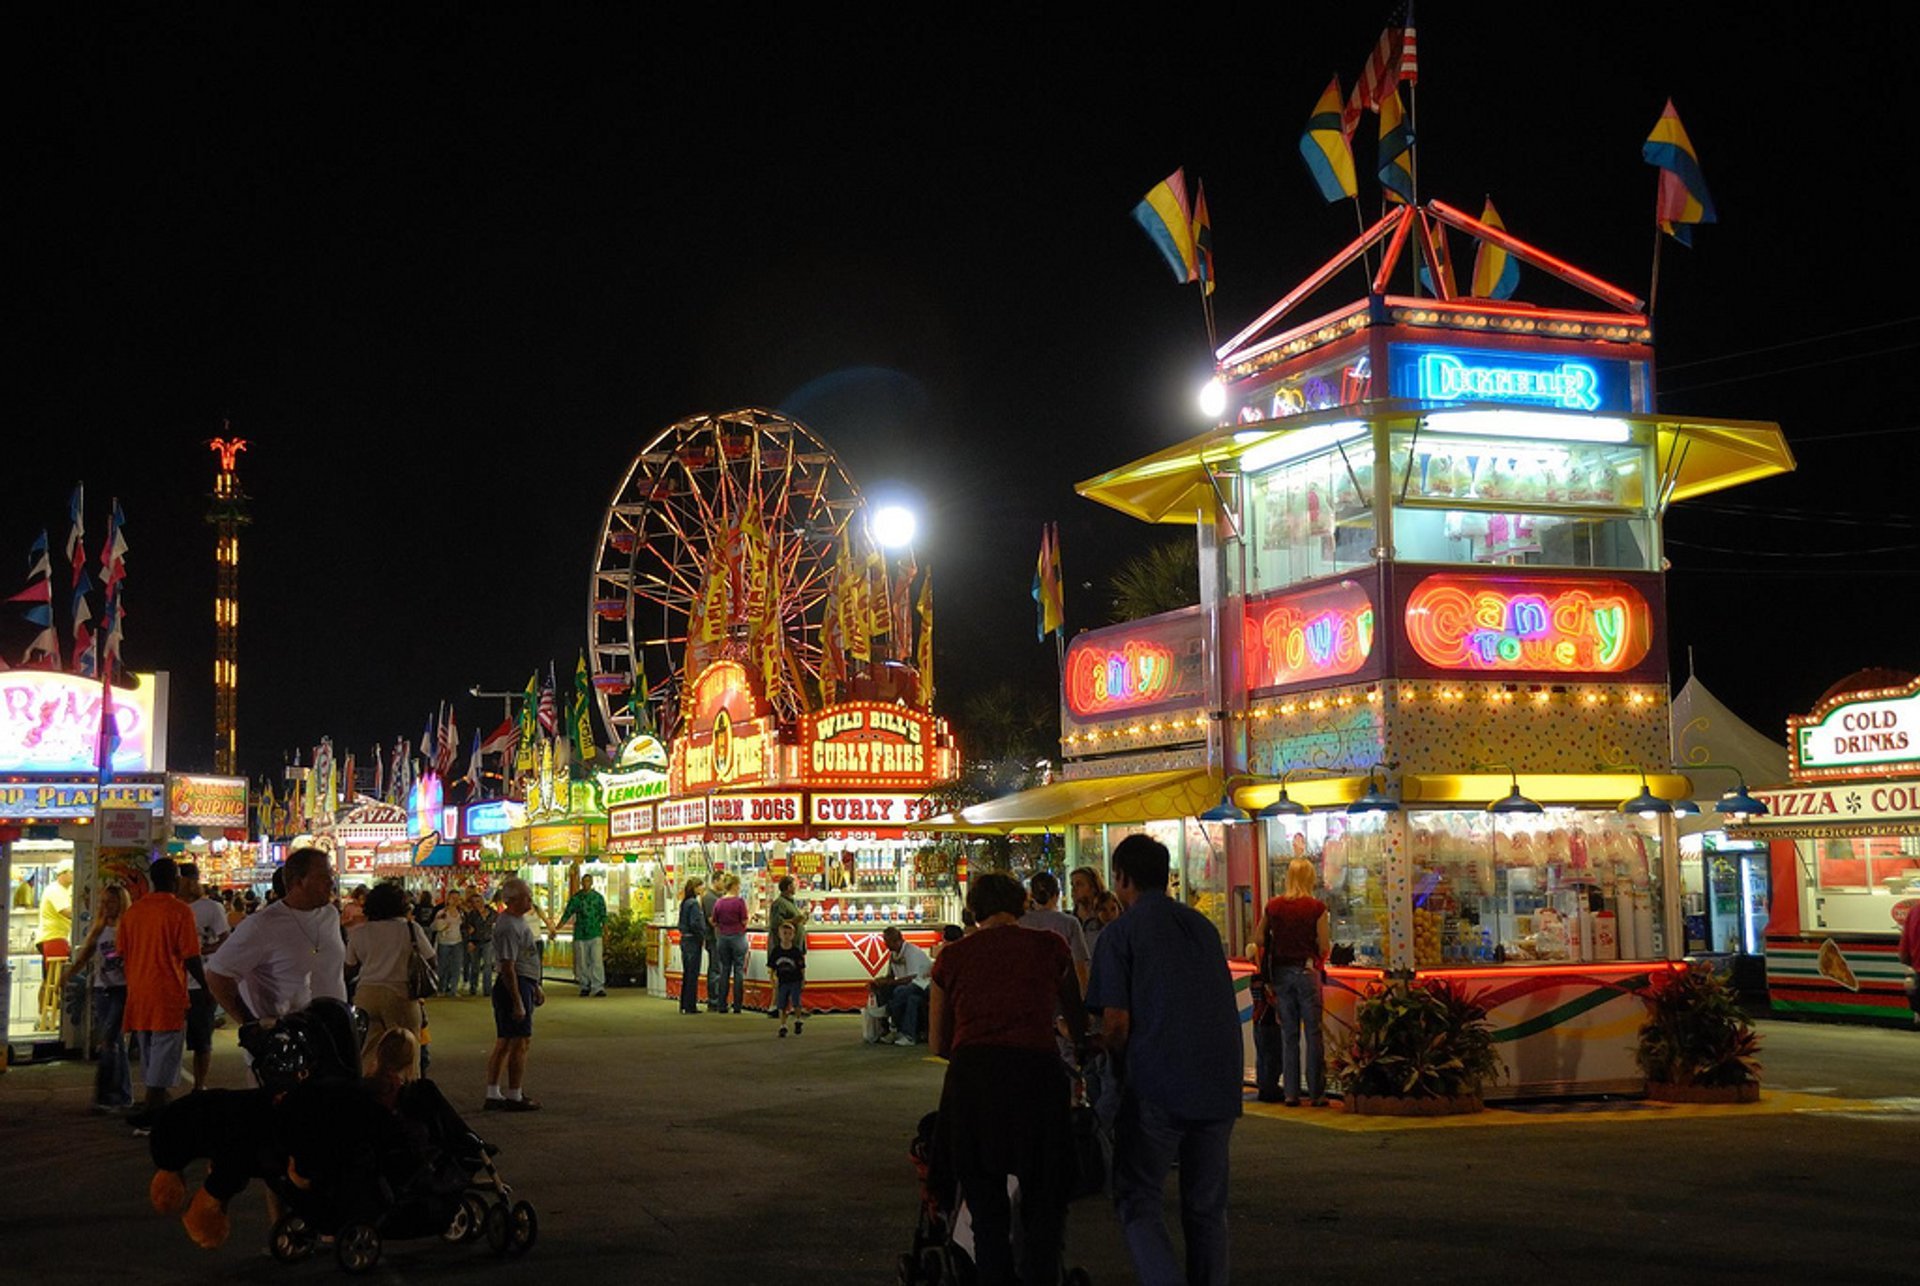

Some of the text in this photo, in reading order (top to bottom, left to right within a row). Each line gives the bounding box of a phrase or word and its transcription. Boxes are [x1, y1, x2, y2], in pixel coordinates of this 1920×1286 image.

[1421, 587, 1628, 667] Candy
[1474, 631, 1594, 666] Tower
[1071, 640, 1172, 712] Candy
[816, 710, 921, 744] WILD BILL'S
[1842, 710, 1898, 732] COLD
[1834, 731, 1909, 755] DRINKS
[812, 740, 924, 774] CURLY FRIES
[36, 786, 154, 808] PLATTER
[193, 798, 245, 816] SHRIMP
[1755, 792, 1839, 818] PIZZA
[348, 807, 407, 824] PIZZA
[712, 799, 795, 821] CORN DOGS
[817, 799, 893, 820] CURLY
